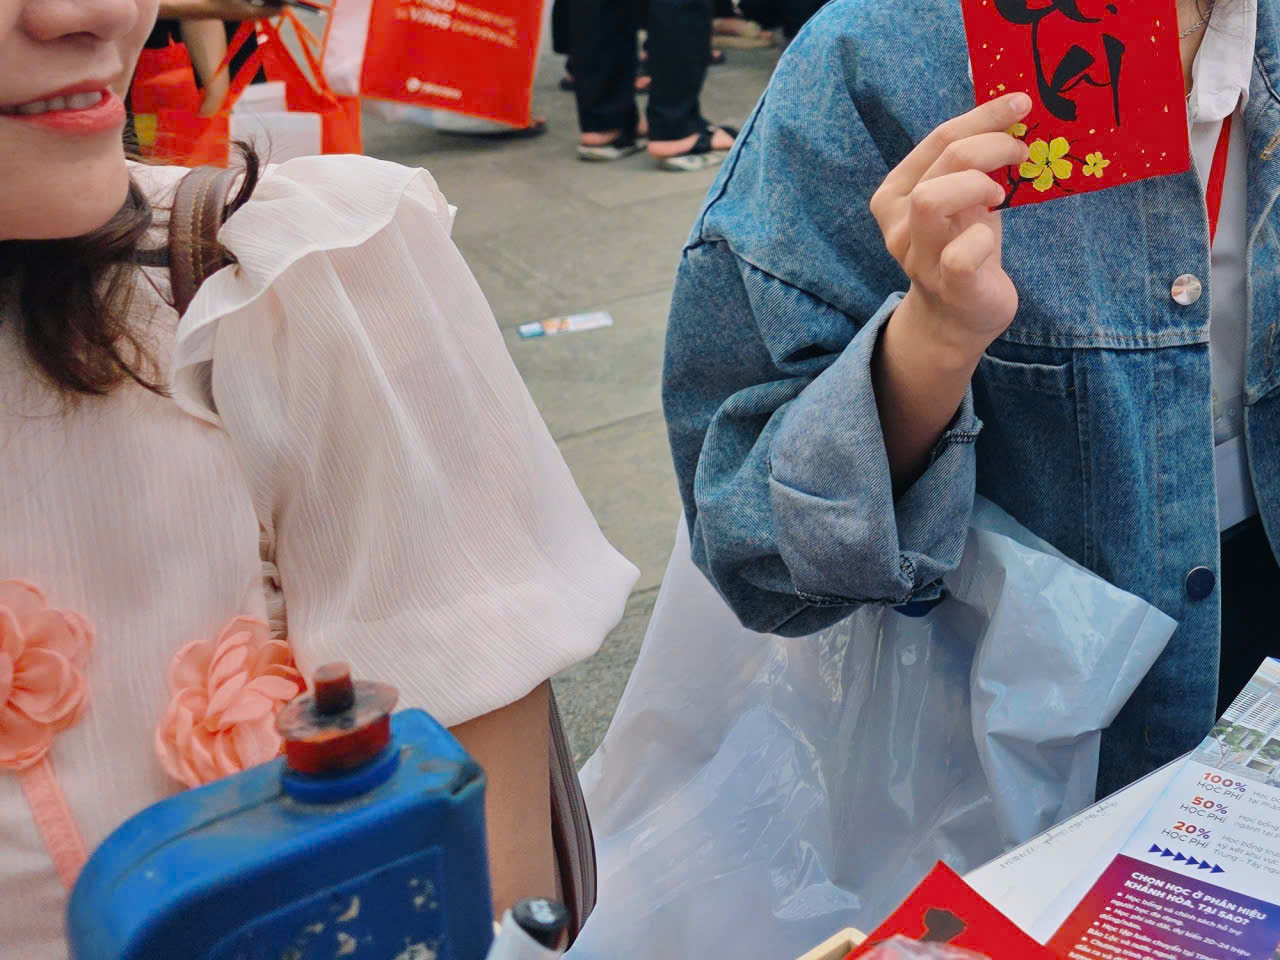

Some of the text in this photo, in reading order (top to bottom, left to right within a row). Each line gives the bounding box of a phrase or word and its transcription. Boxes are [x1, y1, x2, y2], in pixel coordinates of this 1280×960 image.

[1197, 780, 1246, 801] HỌC PHÍ
[1203, 772, 1246, 793] 100%
[1179, 803, 1229, 824] HỌC PHÍ
[1191, 795, 1228, 815] 50%
[1161, 828, 1211, 849] HỌC PHÍ
[1173, 821, 1210, 840] 20%
[1124, 880, 1166, 898] KHÁNH
[1198, 903, 1217, 915] TẠI
[1217, 911, 1250, 925] SAO?
[1131, 872, 1166, 888] CHỌN
[1165, 882, 1192, 896] HỌC
[1203, 895, 1238, 911] PHÂN
[1237, 906, 1267, 920] HIỆU
